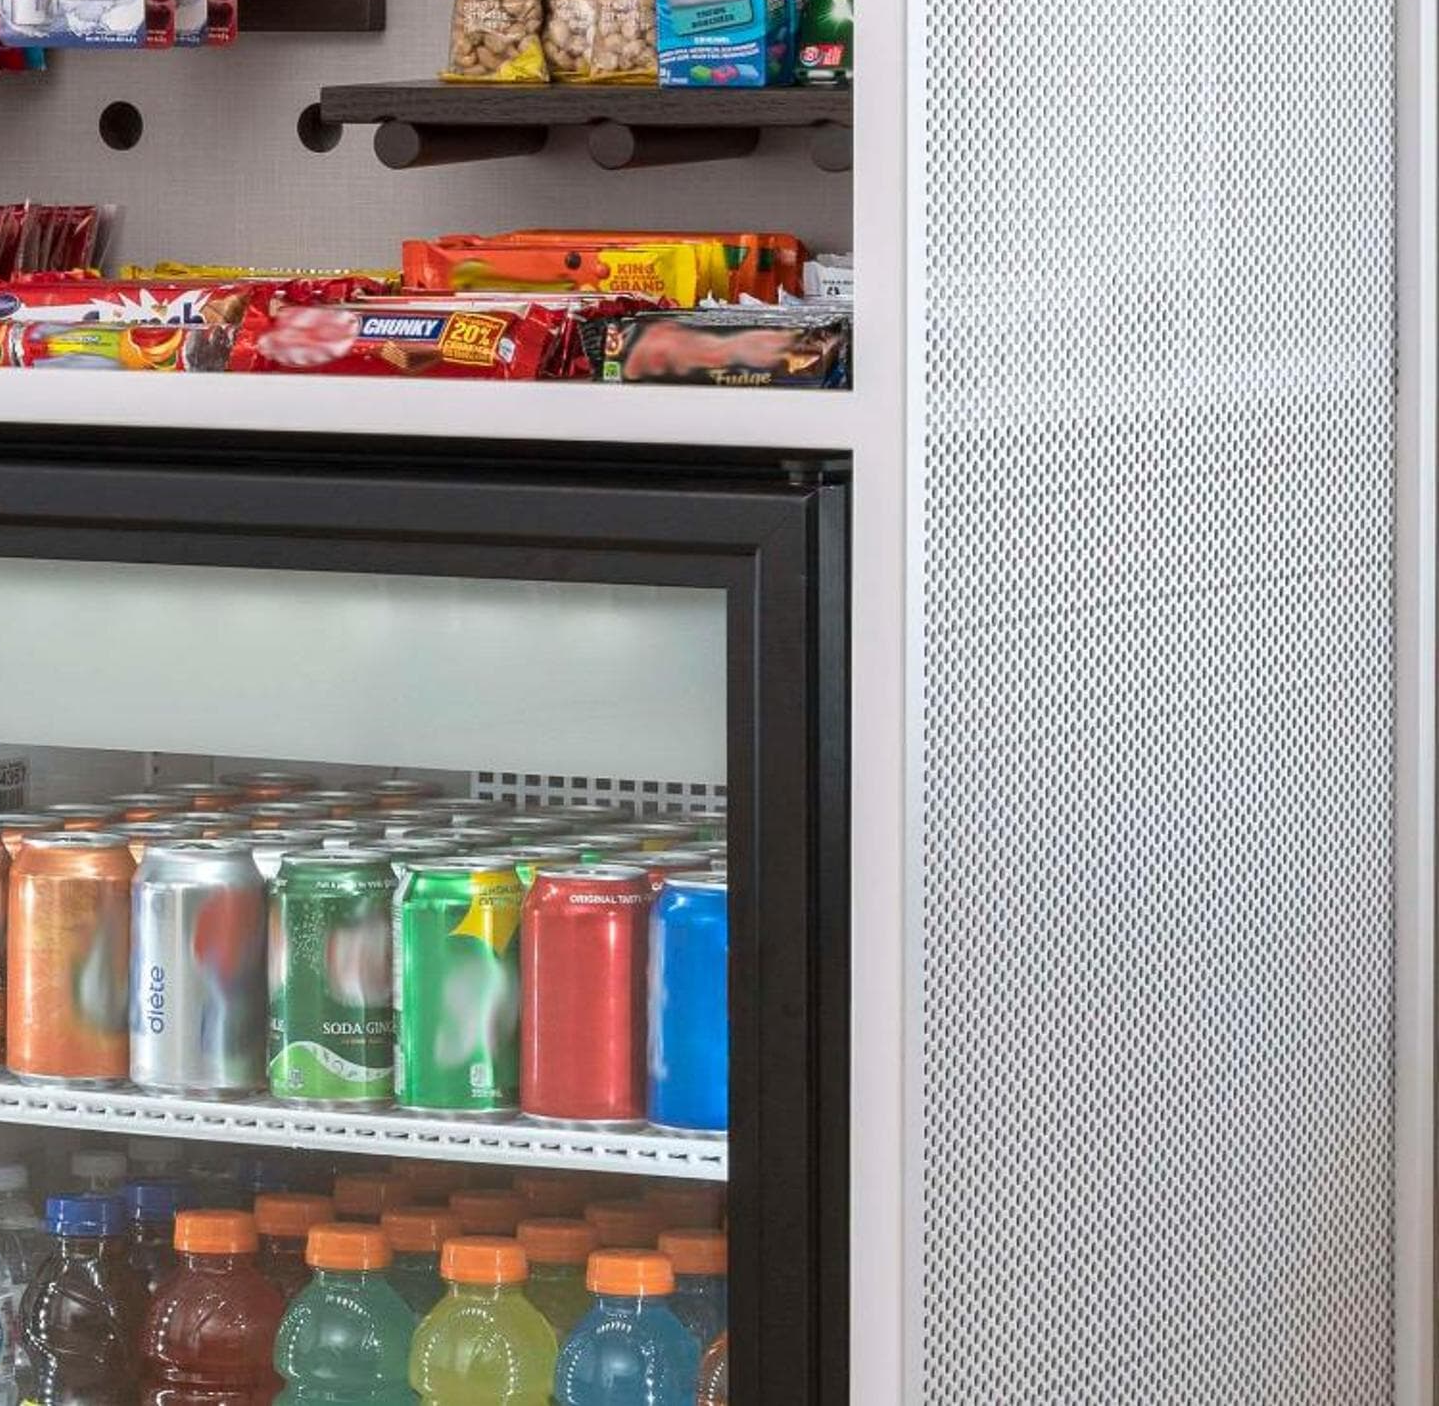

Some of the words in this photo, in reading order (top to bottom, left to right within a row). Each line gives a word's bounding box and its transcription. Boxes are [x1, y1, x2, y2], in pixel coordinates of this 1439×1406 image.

[617, 263, 655, 275] KING
[612, 279, 665, 292] GRAND
[363, 318, 439, 336] CHUNKY
[451, 322, 491, 346] 20%
[710, 369, 772, 385] Fudge
[323, 1021, 363, 1034] SODA
